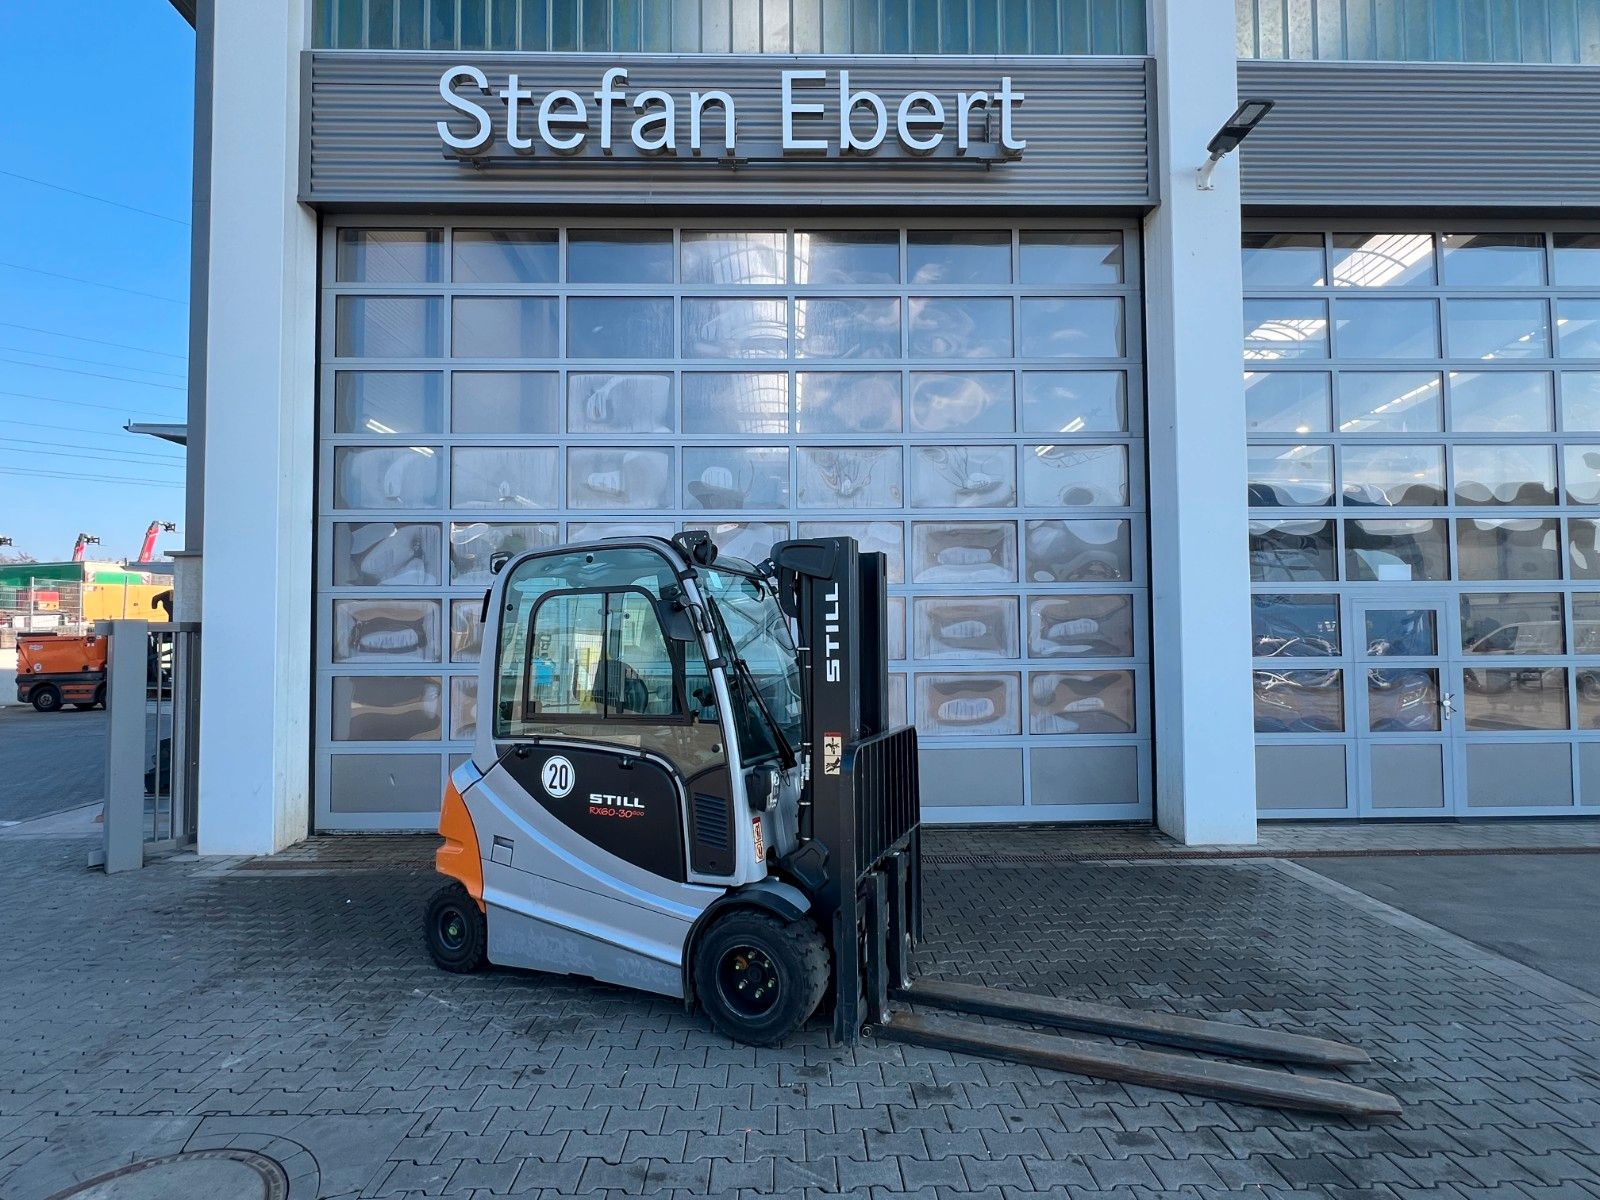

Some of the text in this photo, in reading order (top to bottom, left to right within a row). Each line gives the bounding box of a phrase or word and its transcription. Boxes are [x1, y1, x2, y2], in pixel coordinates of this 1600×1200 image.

[436, 65, 1027, 151] Stefan Ebert
[825, 582, 841, 682] STILL
[548, 763, 569, 791] 20
[589, 793, 646, 809] STILL
